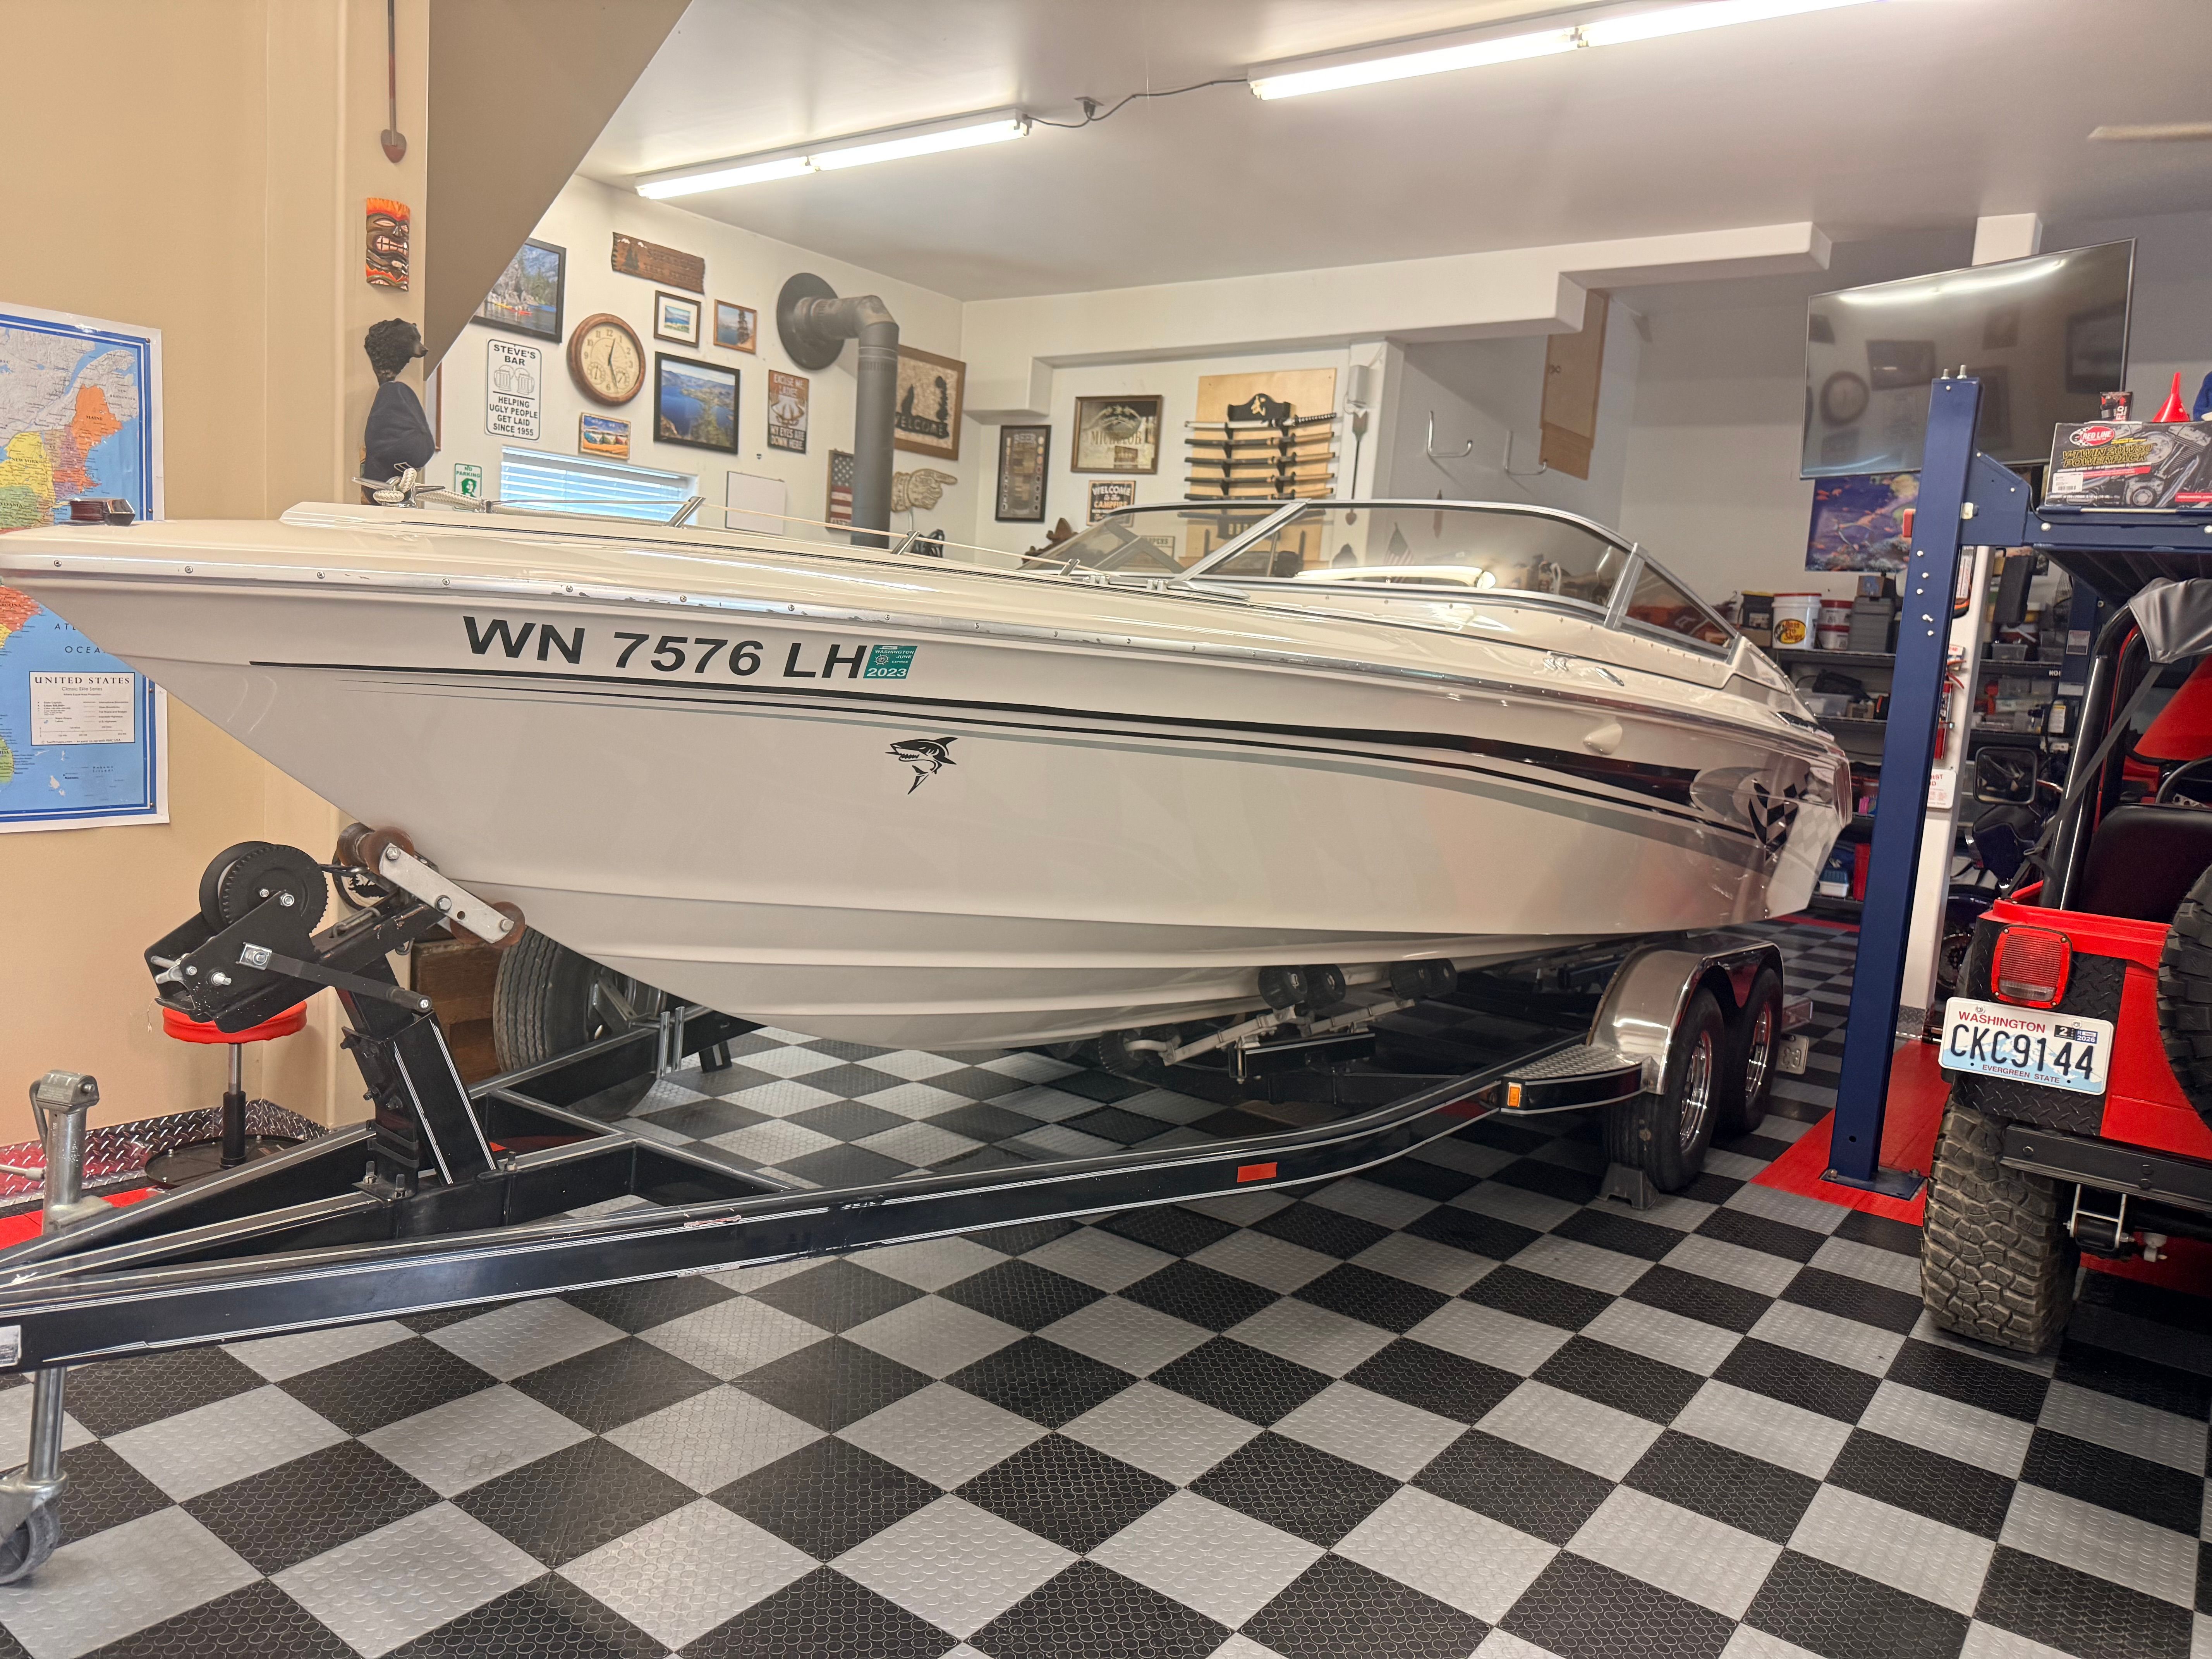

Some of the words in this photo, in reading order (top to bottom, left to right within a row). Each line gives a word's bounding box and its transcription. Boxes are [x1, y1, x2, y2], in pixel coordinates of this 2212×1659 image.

[494, 344, 536, 359] STEVE'S
[505, 356, 525, 366] BAR
[498, 396, 530, 408] HELPING
[489, 404, 508, 413] UGLY
[511, 407, 538, 419] PEOPLE
[497, 414, 512, 423] GET
[514, 417, 530, 426] LAID
[493, 423, 515, 433] SINCE
[517, 427, 534, 436] 1955
[1014, 433, 1036, 444] BEER
[2063, 452, 2148, 468] POWERPACK
[1092, 486, 1131, 496] WELCOME
[463, 616, 585, 664] WN
[614, 632, 764, 676] 7576
[783, 642, 867, 678] LH
[867, 668, 907, 677] 2023
[1959, 1011, 2046, 1033] WASHINGTON
[2059, 1027, 2068, 1036] 2
[1950, 1024, 2094, 1080] CKC9144
[1982, 1064, 2030, 1078] EVERGREEN
[2034, 1073, 2060, 1084] STATE
